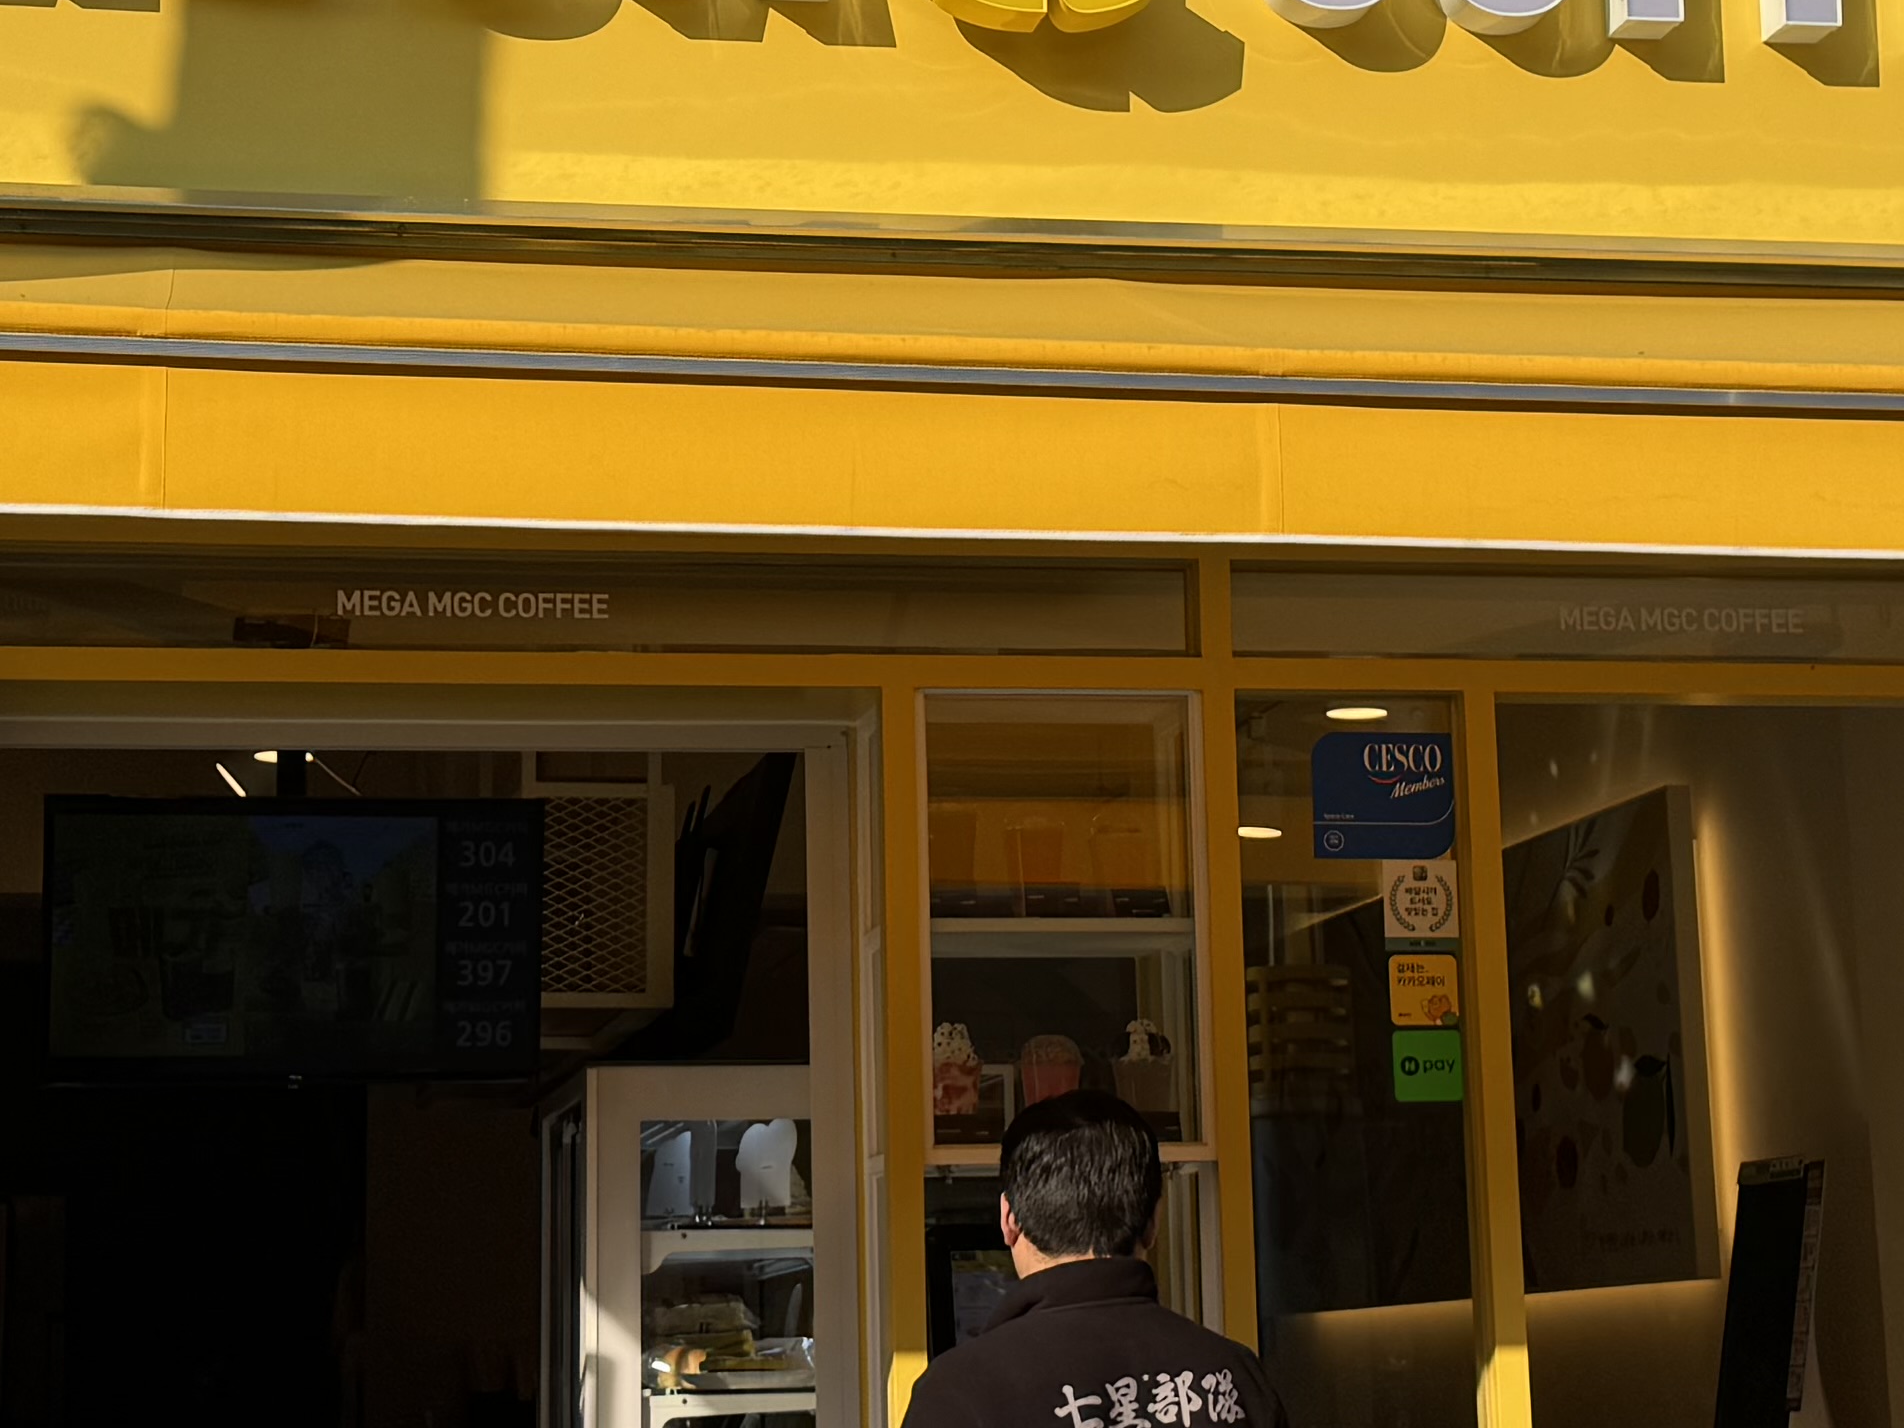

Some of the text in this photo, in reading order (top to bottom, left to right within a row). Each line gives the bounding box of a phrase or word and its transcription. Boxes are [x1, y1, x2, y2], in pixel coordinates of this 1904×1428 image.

[336, 589, 610, 620] MEGA MGC COFFEE
[1559, 605, 1804, 635] MEGA MGC COFFEE
[1362, 742, 1443, 774] CESCO
[1389, 775, 1446, 801] Members
[458, 840, 517, 869] 304
[457, 900, 512, 929] 201
[456, 959, 513, 987] 397
[455, 1020, 513, 1049] 296
[1422, 1057, 1456, 1074] pay
